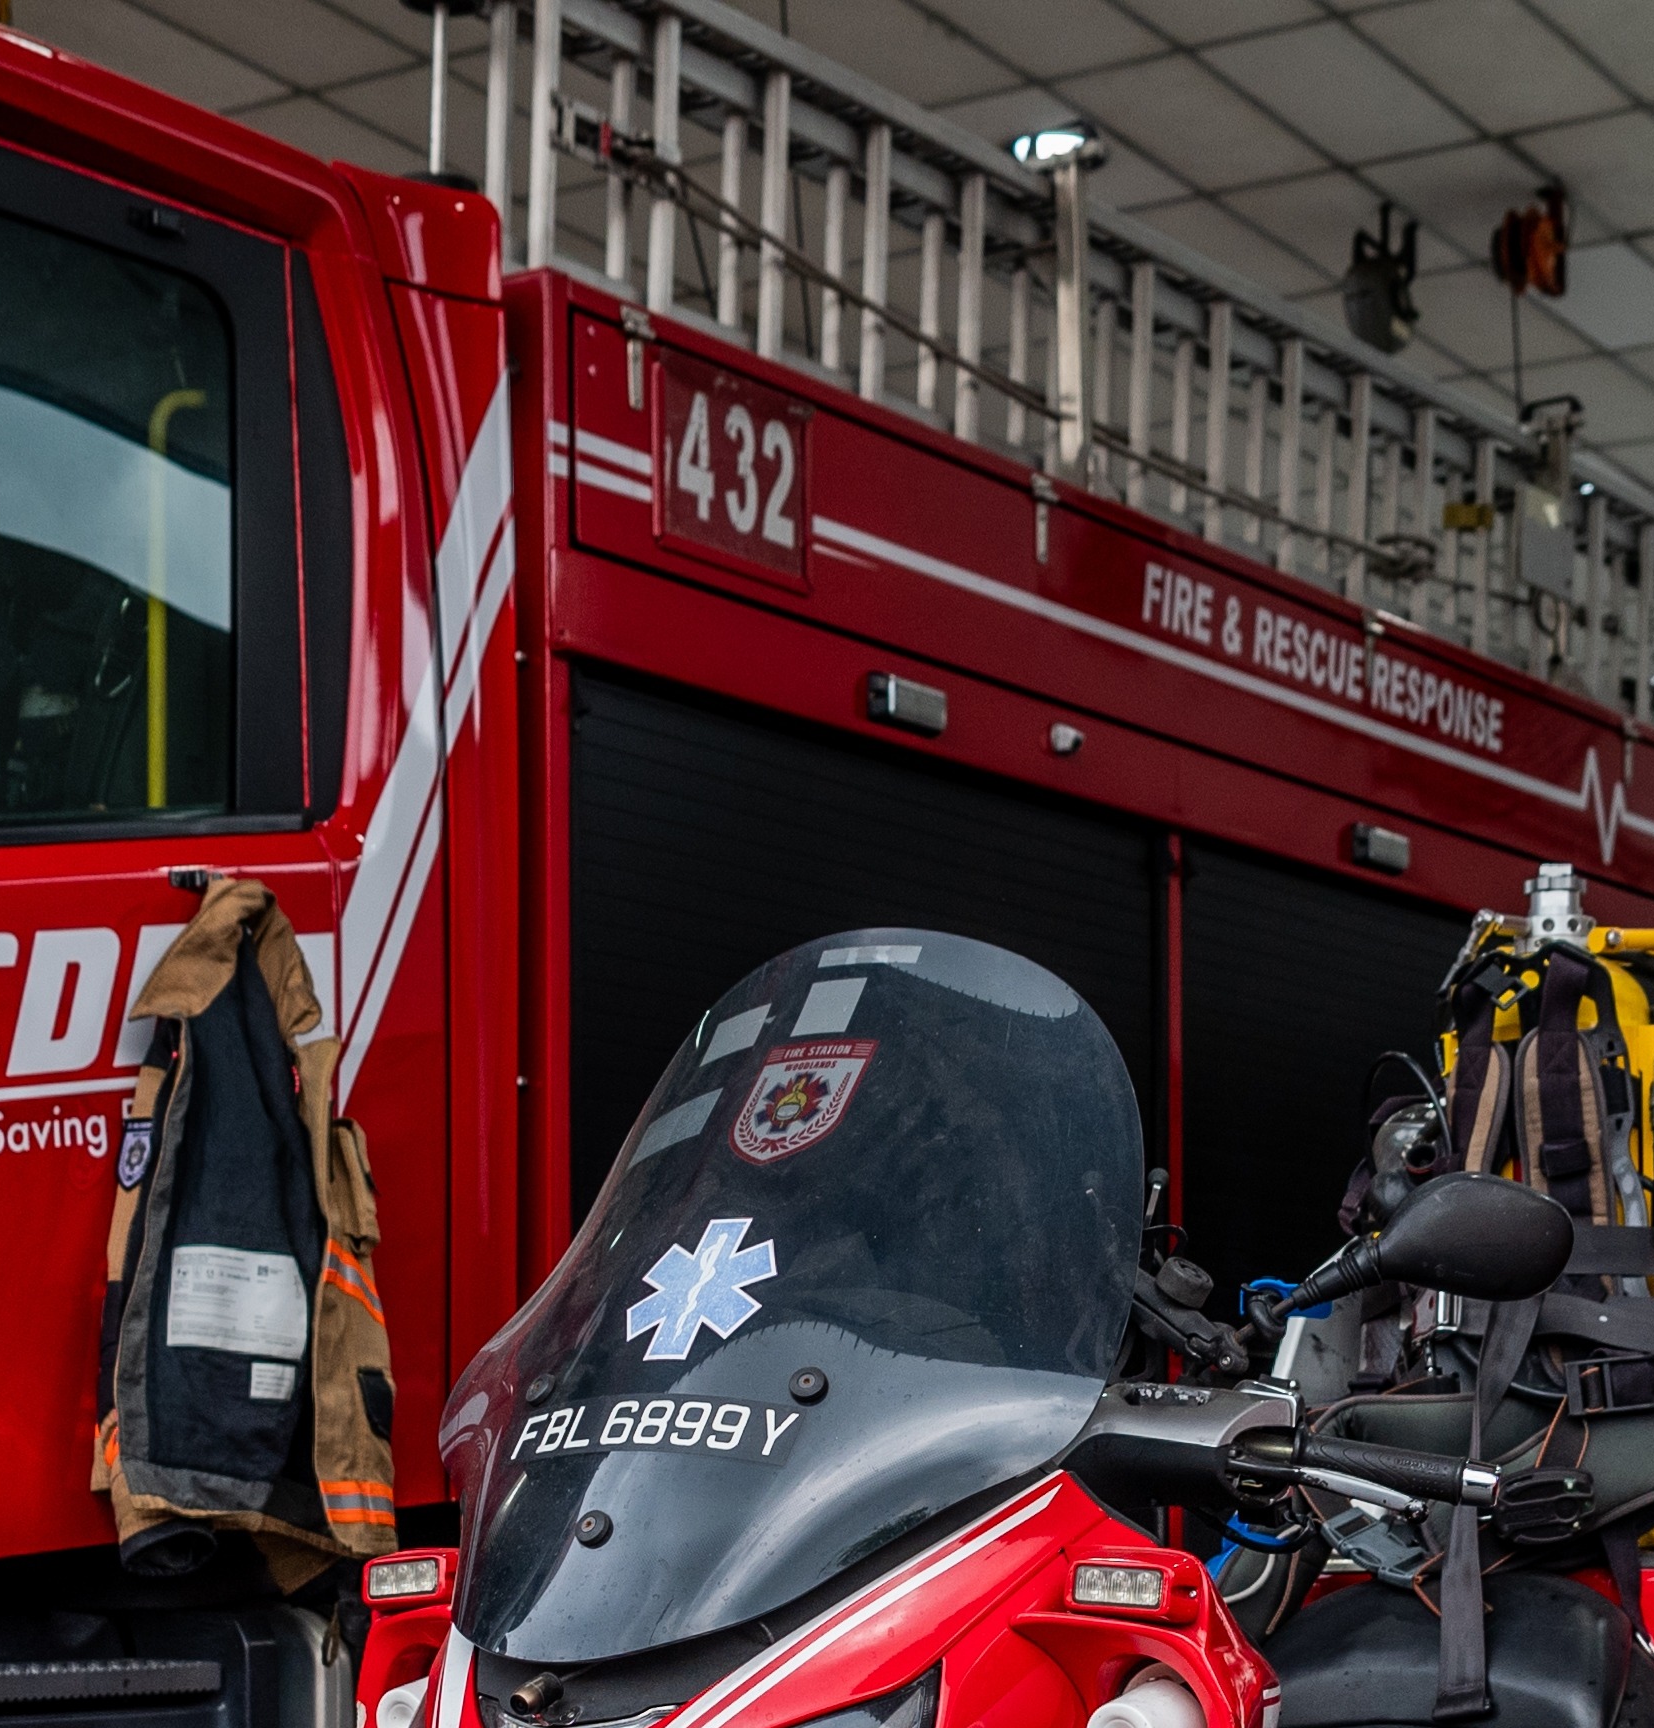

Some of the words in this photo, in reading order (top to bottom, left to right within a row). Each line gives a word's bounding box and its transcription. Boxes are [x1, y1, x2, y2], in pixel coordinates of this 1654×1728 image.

[678, 392, 795, 549] 432
[1141, 561, 1214, 645] FIRE
[1221, 595, 1243, 657] &
[1253, 606, 1365, 702] RESCUE
[1370, 654, 1505, 753] RESPONSE
[785, 1047, 806, 1059] FIRE
[808, 1045, 852, 1056] STATION
[785, 1060, 838, 1072] WOODLANDS
[510, 1404, 590, 1462] FBL
[598, 1399, 752, 1452] 6899
[760, 1408, 801, 1457] Y
